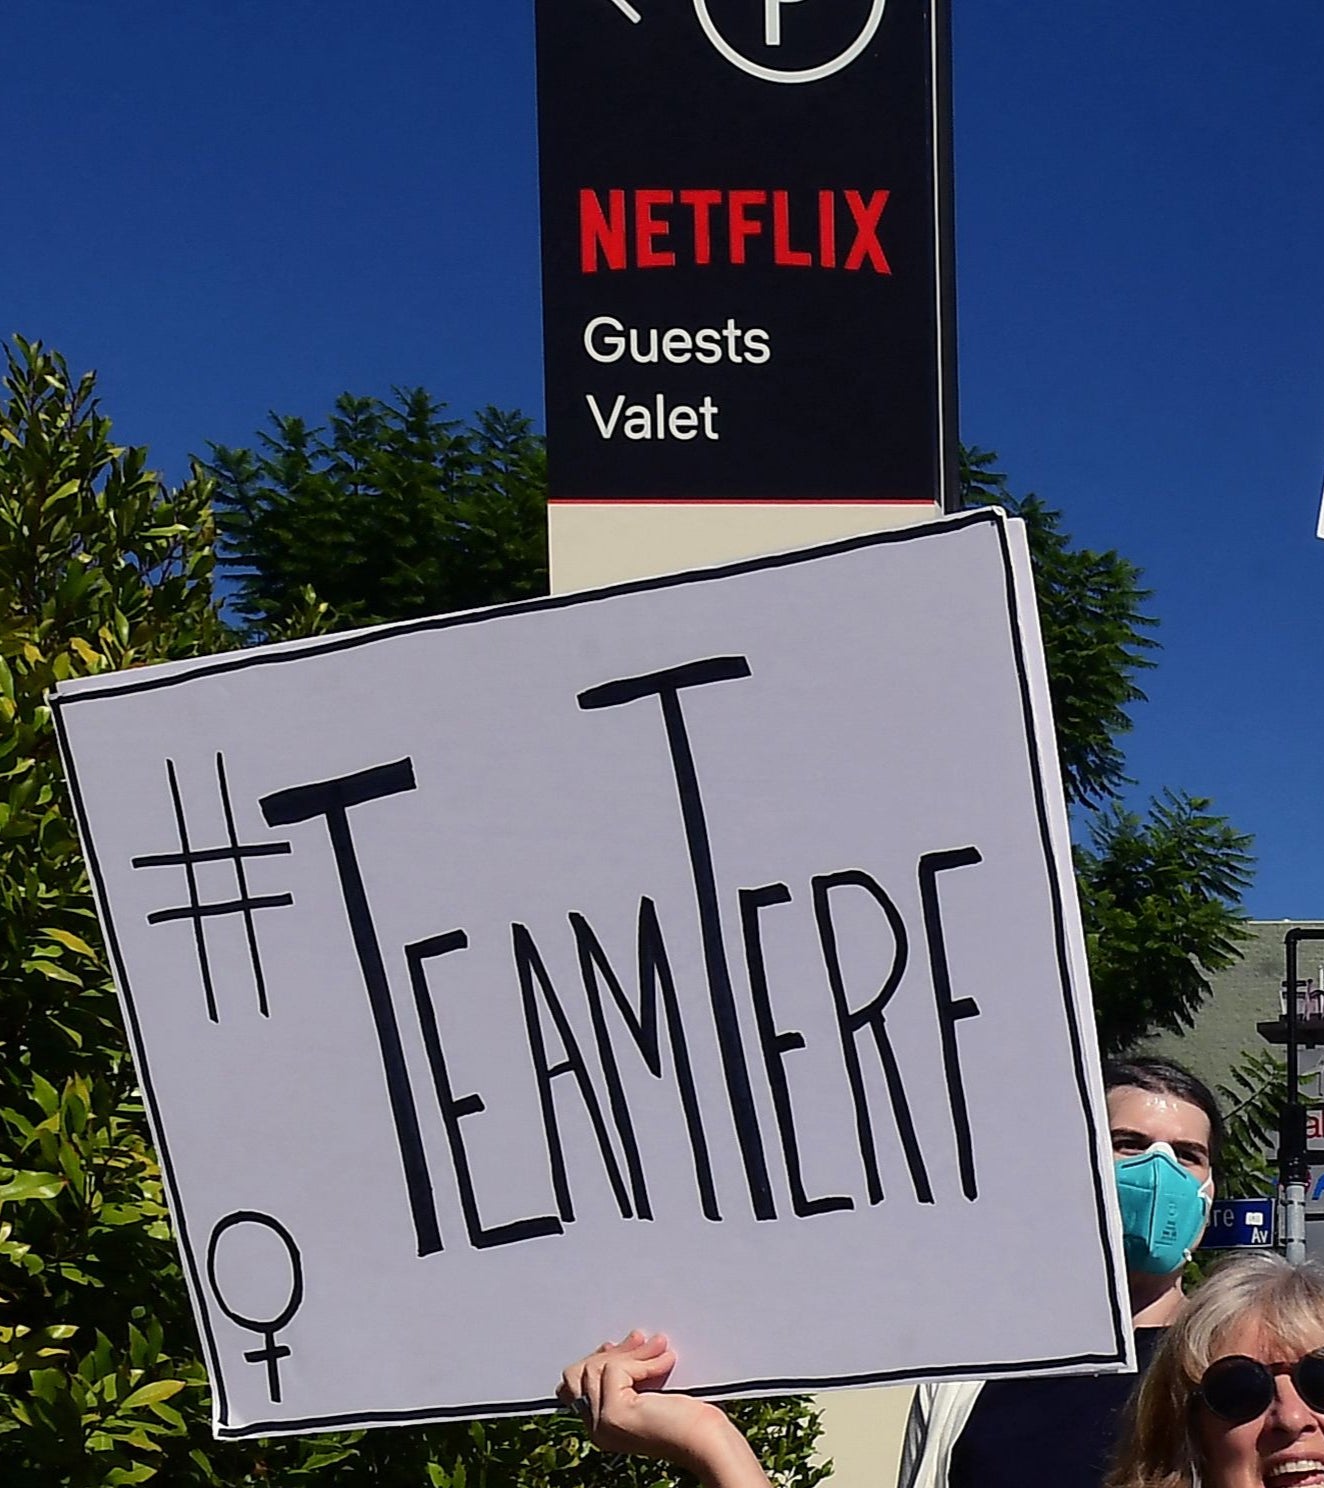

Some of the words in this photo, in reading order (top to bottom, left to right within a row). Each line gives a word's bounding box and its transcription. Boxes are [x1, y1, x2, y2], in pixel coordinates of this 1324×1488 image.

[579, 188, 892, 276] NETFLIX
[584, 316, 771, 364] Guests
[586, 394, 719, 440] Valet
[1251, 1227, 1269, 1244] Av
